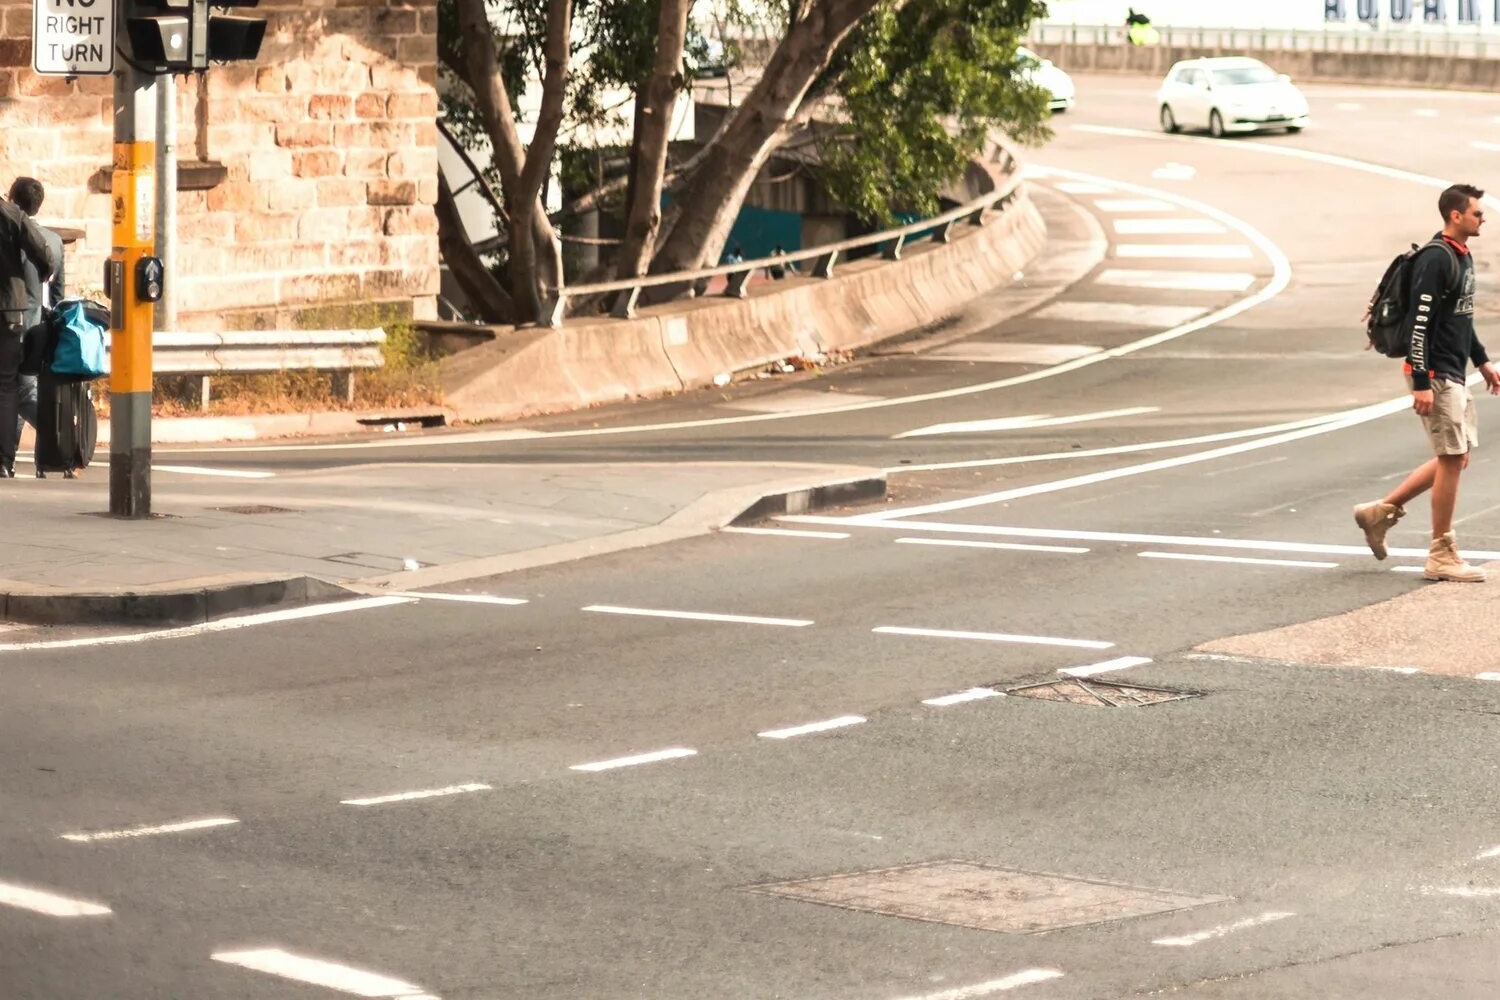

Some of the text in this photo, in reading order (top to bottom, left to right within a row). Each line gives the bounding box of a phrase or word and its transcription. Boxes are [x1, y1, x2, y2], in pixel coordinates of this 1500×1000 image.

[46, 17, 104, 35] RIGHT
[48, 43, 103, 62] TURN
[1414, 293, 1433, 330] 1990
